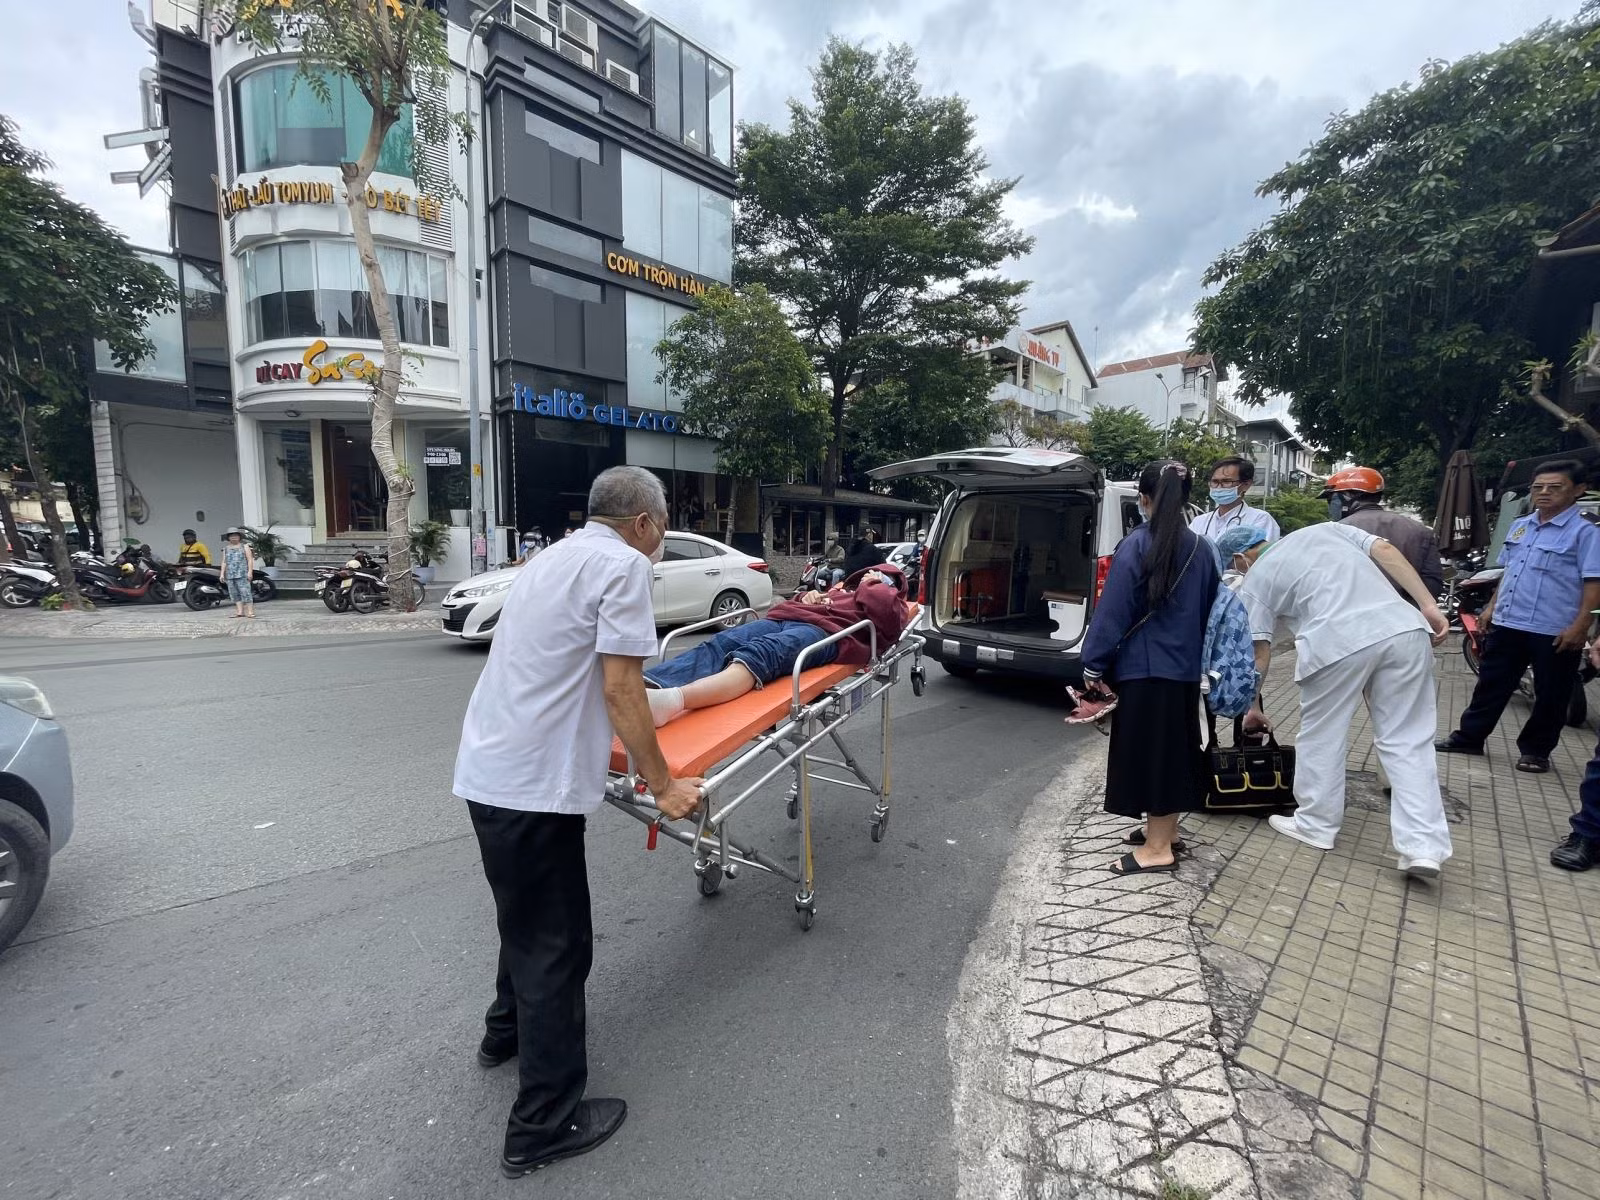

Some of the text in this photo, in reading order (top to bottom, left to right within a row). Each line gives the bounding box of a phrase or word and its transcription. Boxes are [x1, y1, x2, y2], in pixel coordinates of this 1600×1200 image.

[273, 182, 334, 204] TOMYUM
[383, 187, 410, 214] BÍT
[607, 252, 639, 277] CƠM
[643, 264, 677, 291] TRỘN
[680, 274, 705, 297] HÀN
[272, 363, 303, 380] CAY
[593, 404, 678, 433] GELATO
